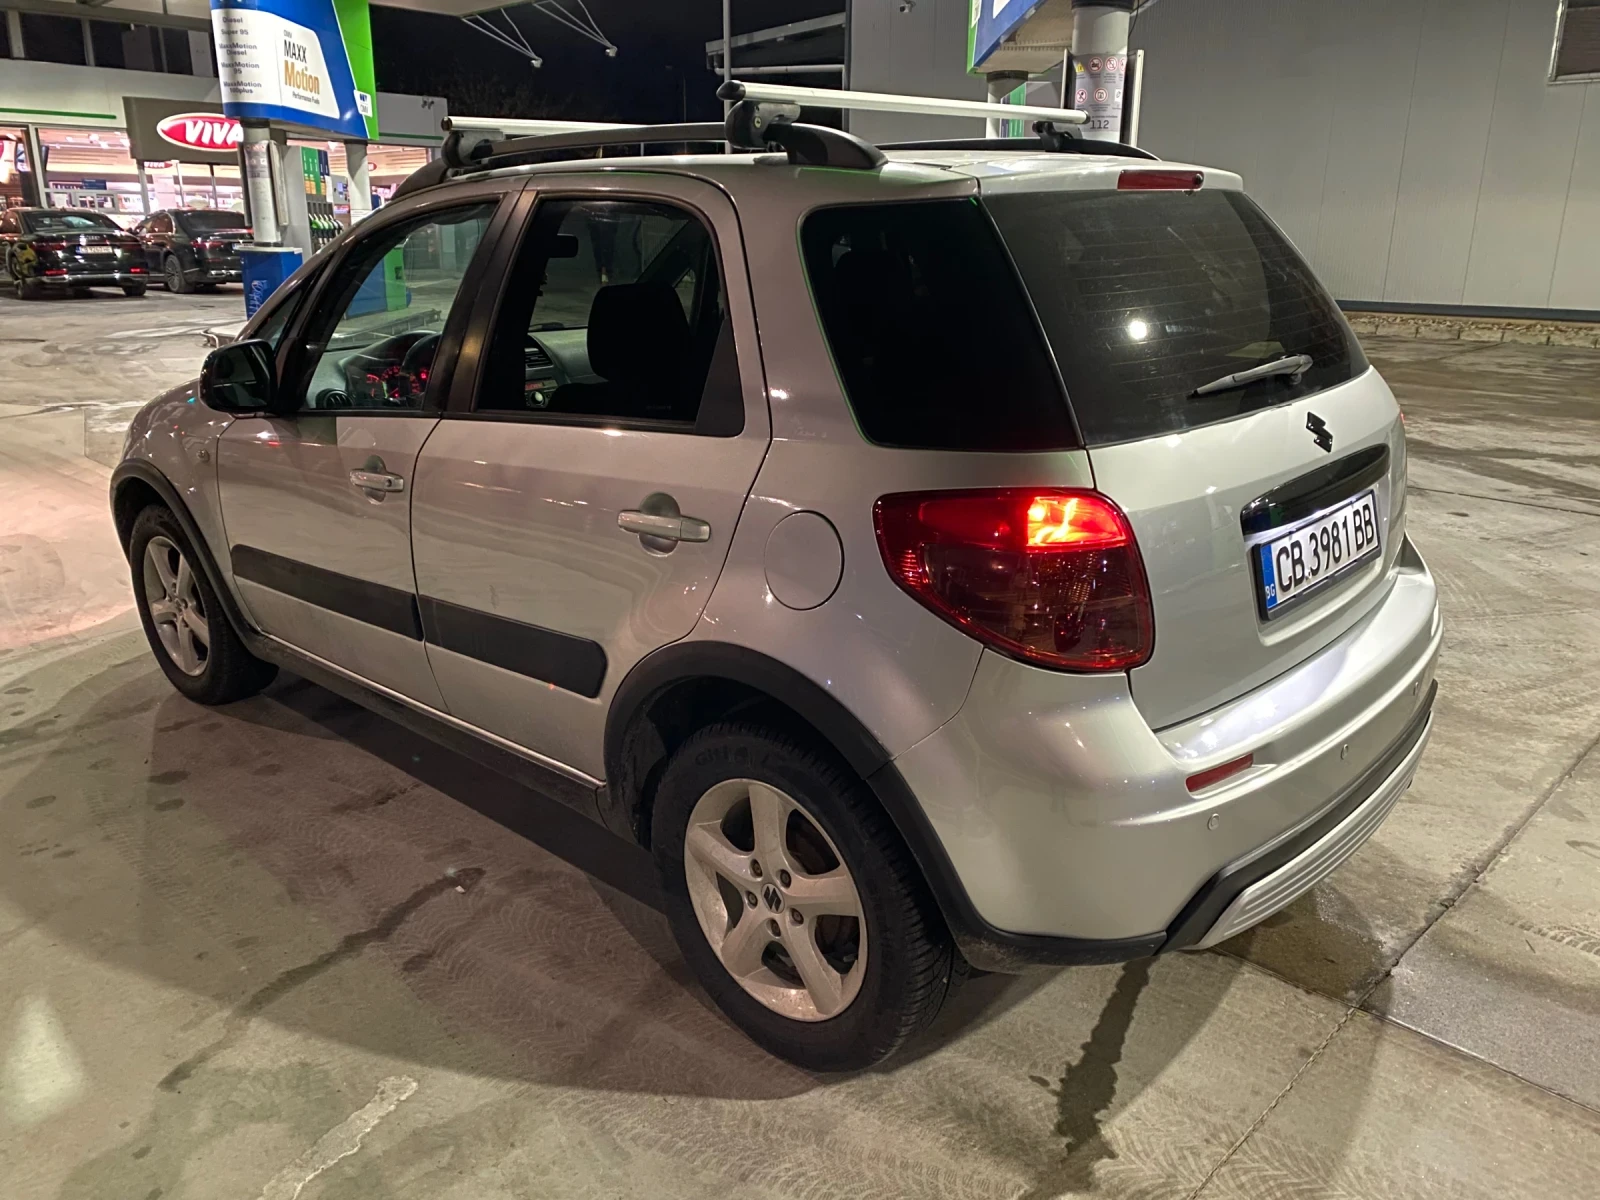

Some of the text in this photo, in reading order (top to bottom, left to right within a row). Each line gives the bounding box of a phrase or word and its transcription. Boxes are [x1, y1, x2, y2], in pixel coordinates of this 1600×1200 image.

[283, 39, 307, 64] MAXX
[284, 60, 320, 95] Motion
[185, 119, 244, 146] VIVA
[1090, 119, 1110, 130] 112
